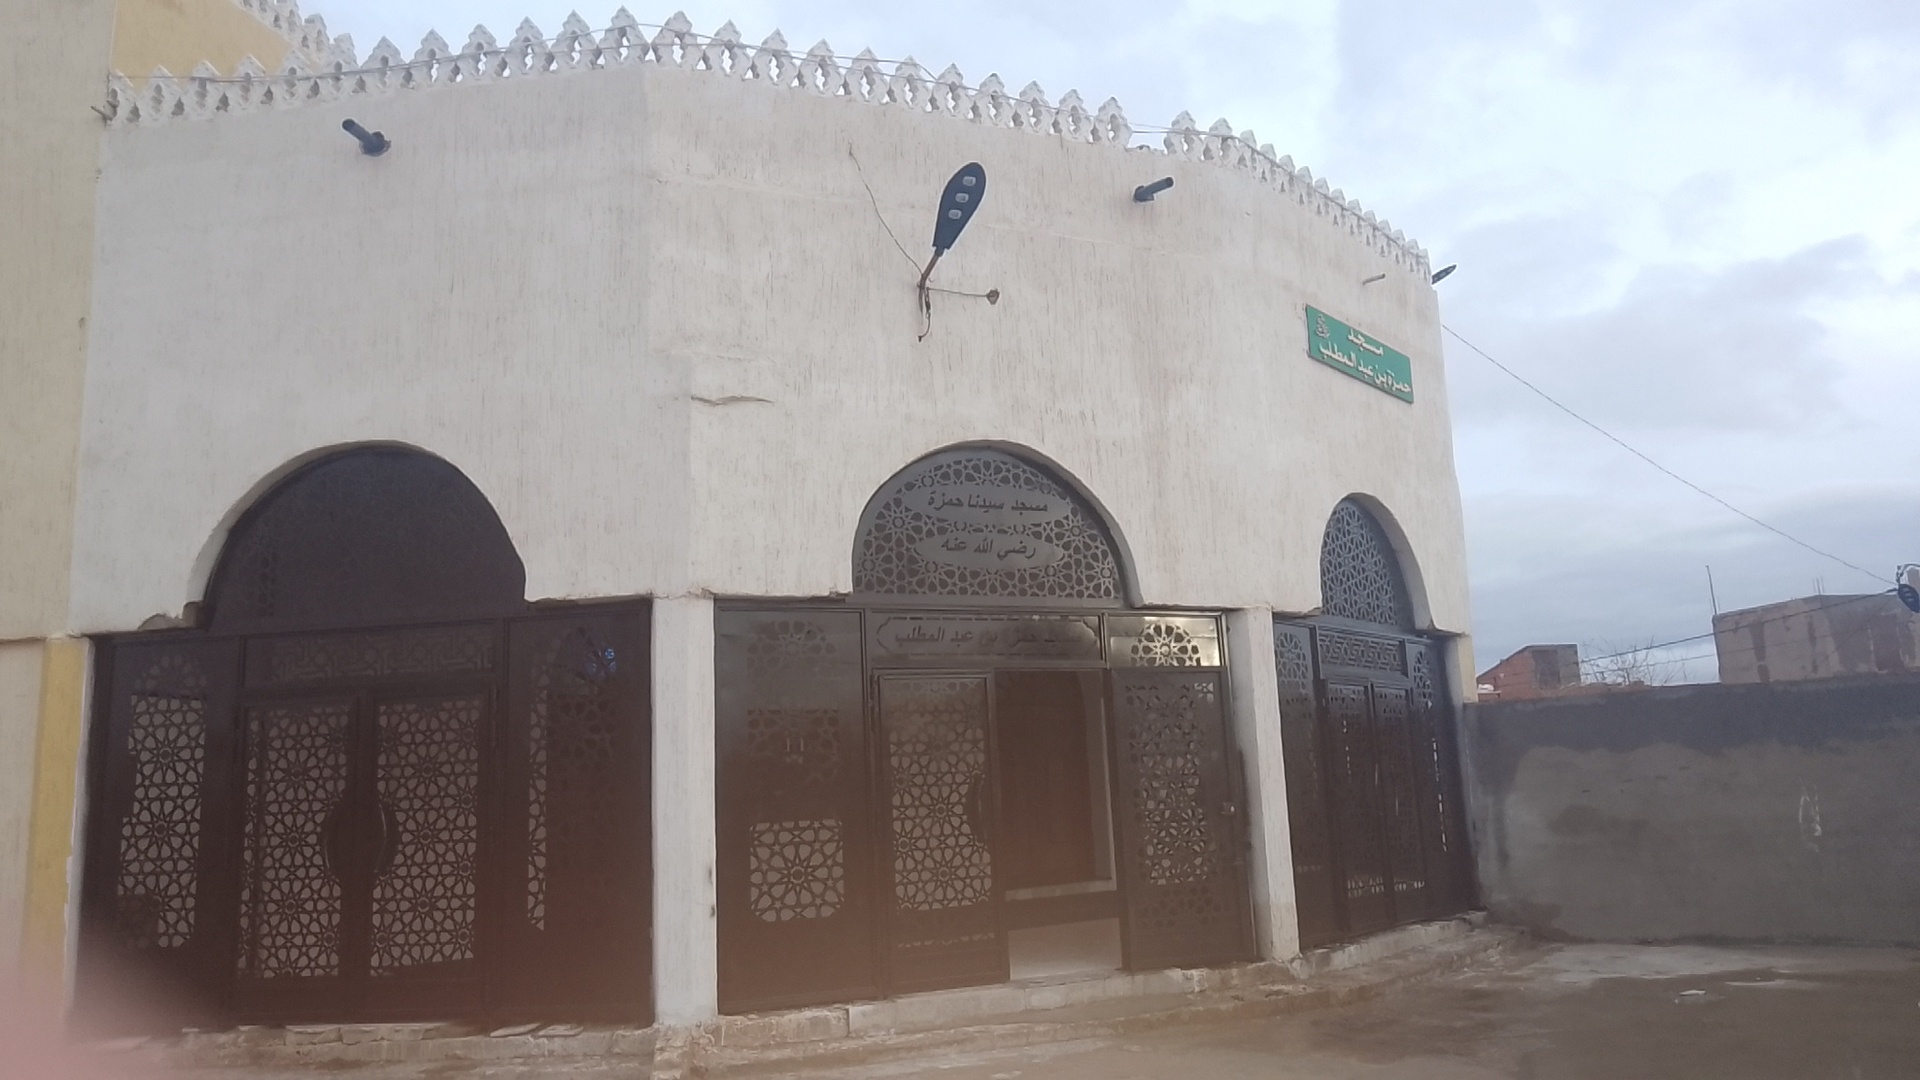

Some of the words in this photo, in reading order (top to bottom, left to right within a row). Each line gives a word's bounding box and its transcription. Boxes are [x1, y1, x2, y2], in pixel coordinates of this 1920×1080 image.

[1347, 327, 1384, 356] مسجد
[1319, 340, 1357, 368] المطلب
[1357, 360, 1374, 379] عبد
[1374, 364, 1388, 389] بن
[928, 491, 964, 510] حمزة
[968, 493, 1005, 513] سيدنا
[1010, 498, 1048, 515] مسجد
[941, 536, 967, 552] عنه
[973, 537, 994, 554] الله
[997, 540, 1036, 560] رضي
[895, 625, 945, 647] المطلب
[949, 630, 974, 647] عبد
